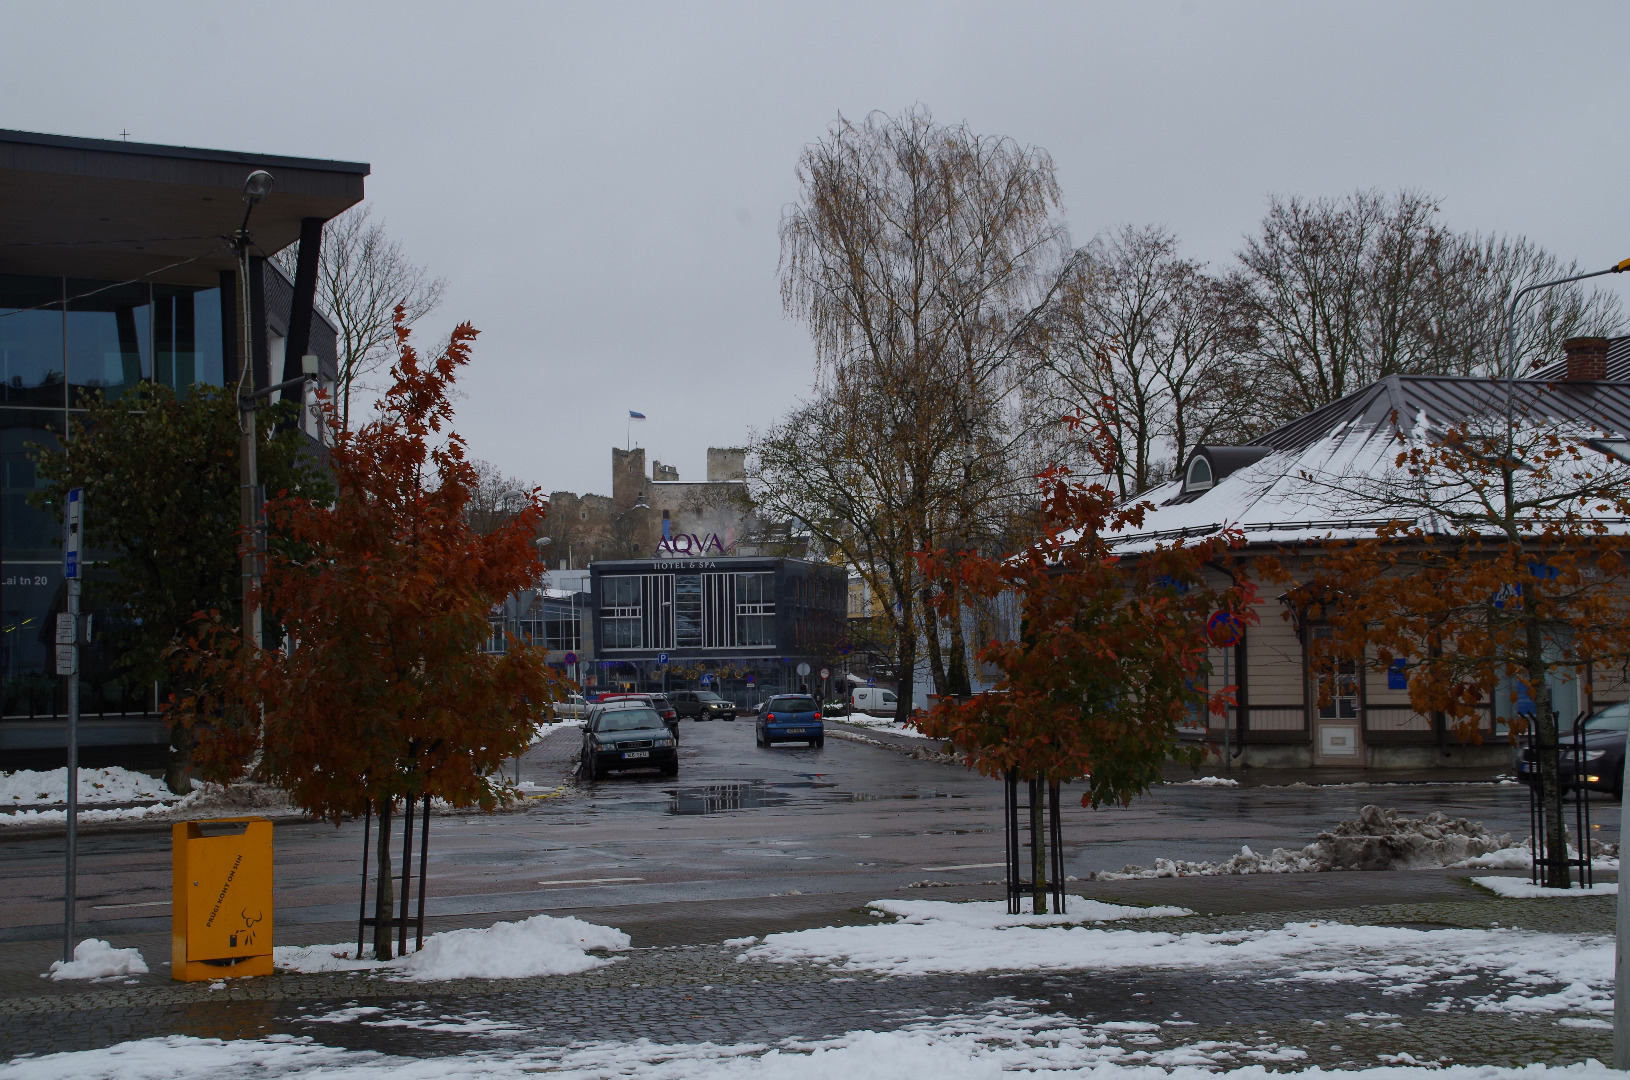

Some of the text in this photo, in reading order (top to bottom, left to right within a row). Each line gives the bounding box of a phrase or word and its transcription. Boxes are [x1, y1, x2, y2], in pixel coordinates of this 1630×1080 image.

[655, 533, 725, 555] AQVA
[654, 562, 686, 570] HOTEL
[19, 576, 31, 585] tn
[35, 576, 47, 585] 20
[217, 882, 230, 904] KOHT
[227, 870, 236, 882] ON
[233, 855, 243, 870] SIIN
